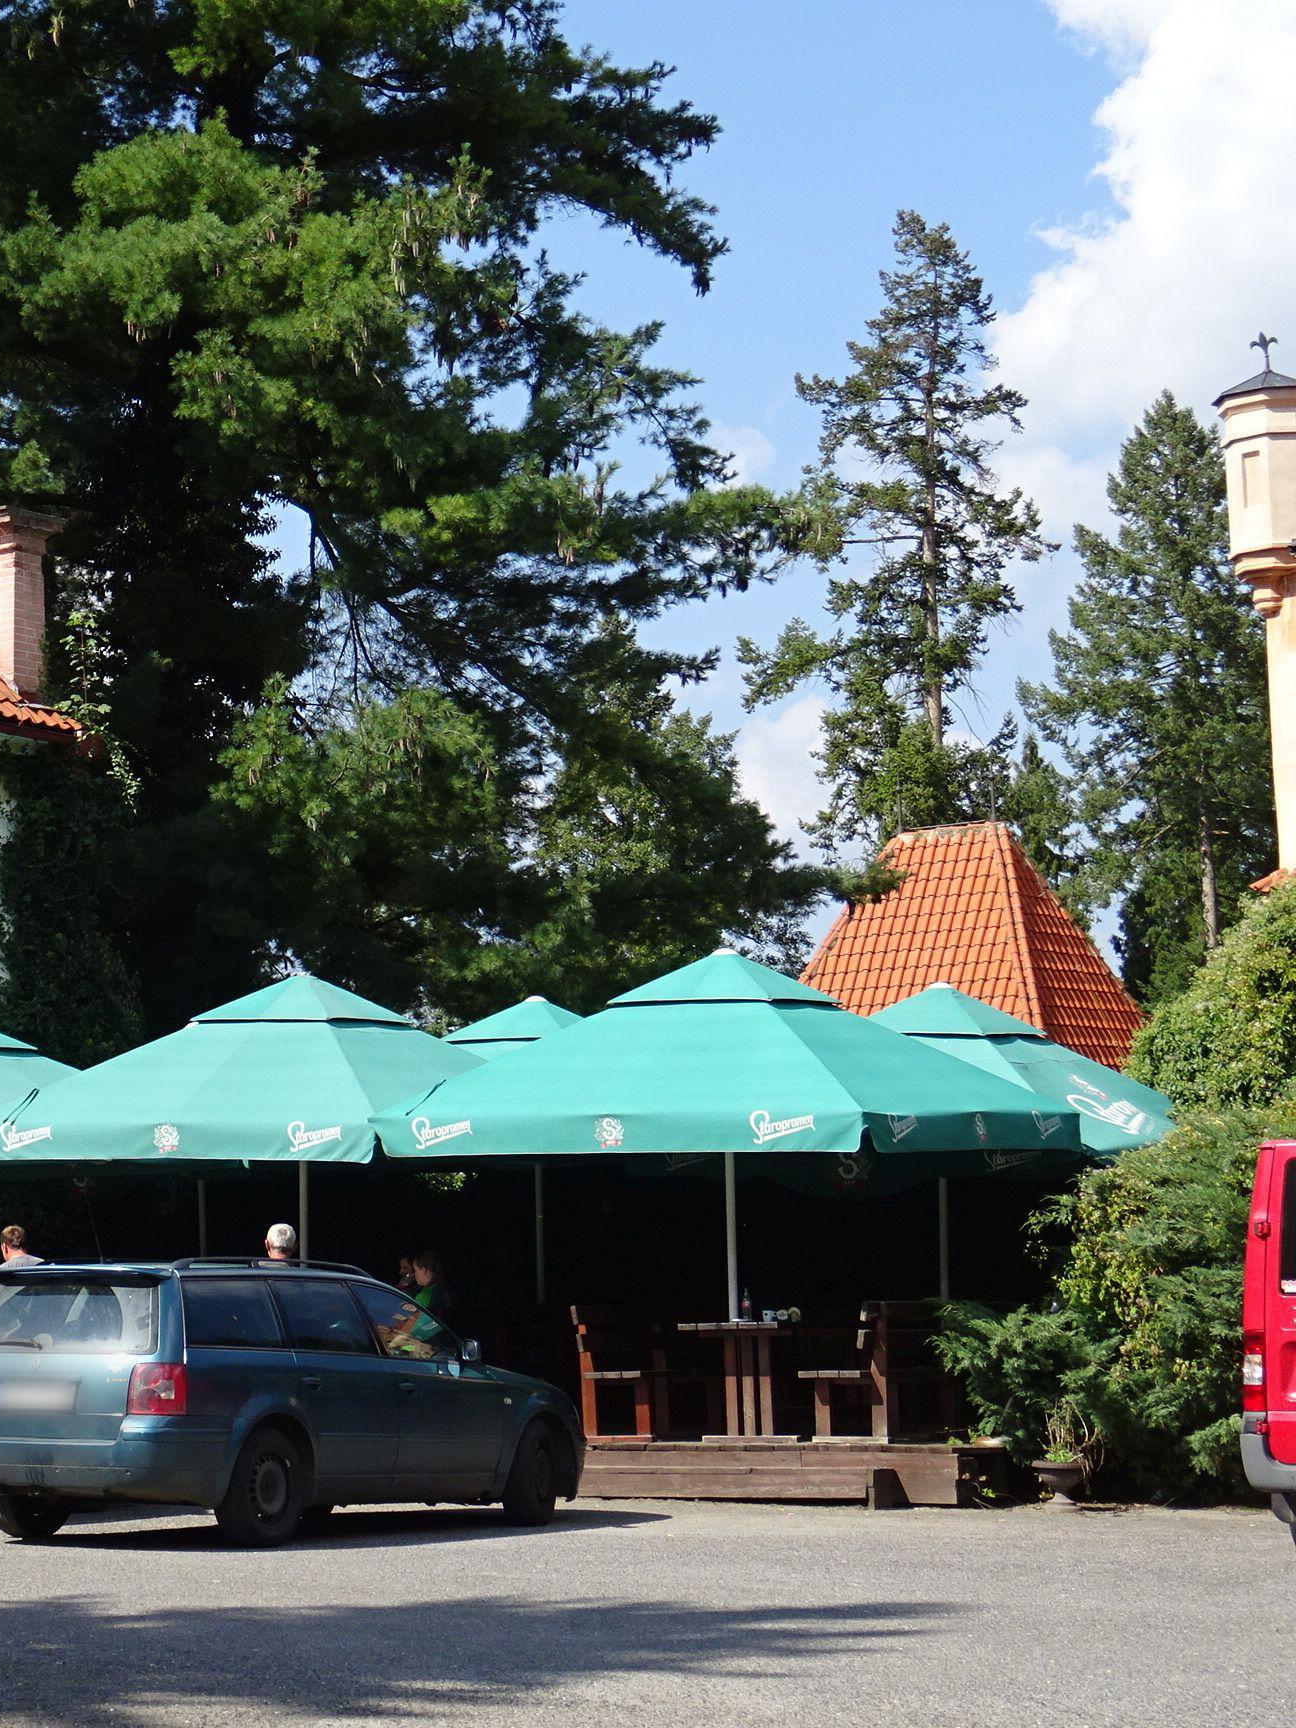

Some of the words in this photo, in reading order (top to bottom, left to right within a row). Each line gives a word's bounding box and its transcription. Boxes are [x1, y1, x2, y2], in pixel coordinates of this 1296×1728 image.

[0, 1121, 52, 1152] Staropramen
[286, 1120, 343, 1152] Staropramen
[411, 1116, 473, 1150] Staropramen
[749, 1109, 816, 1145] Staropramen
